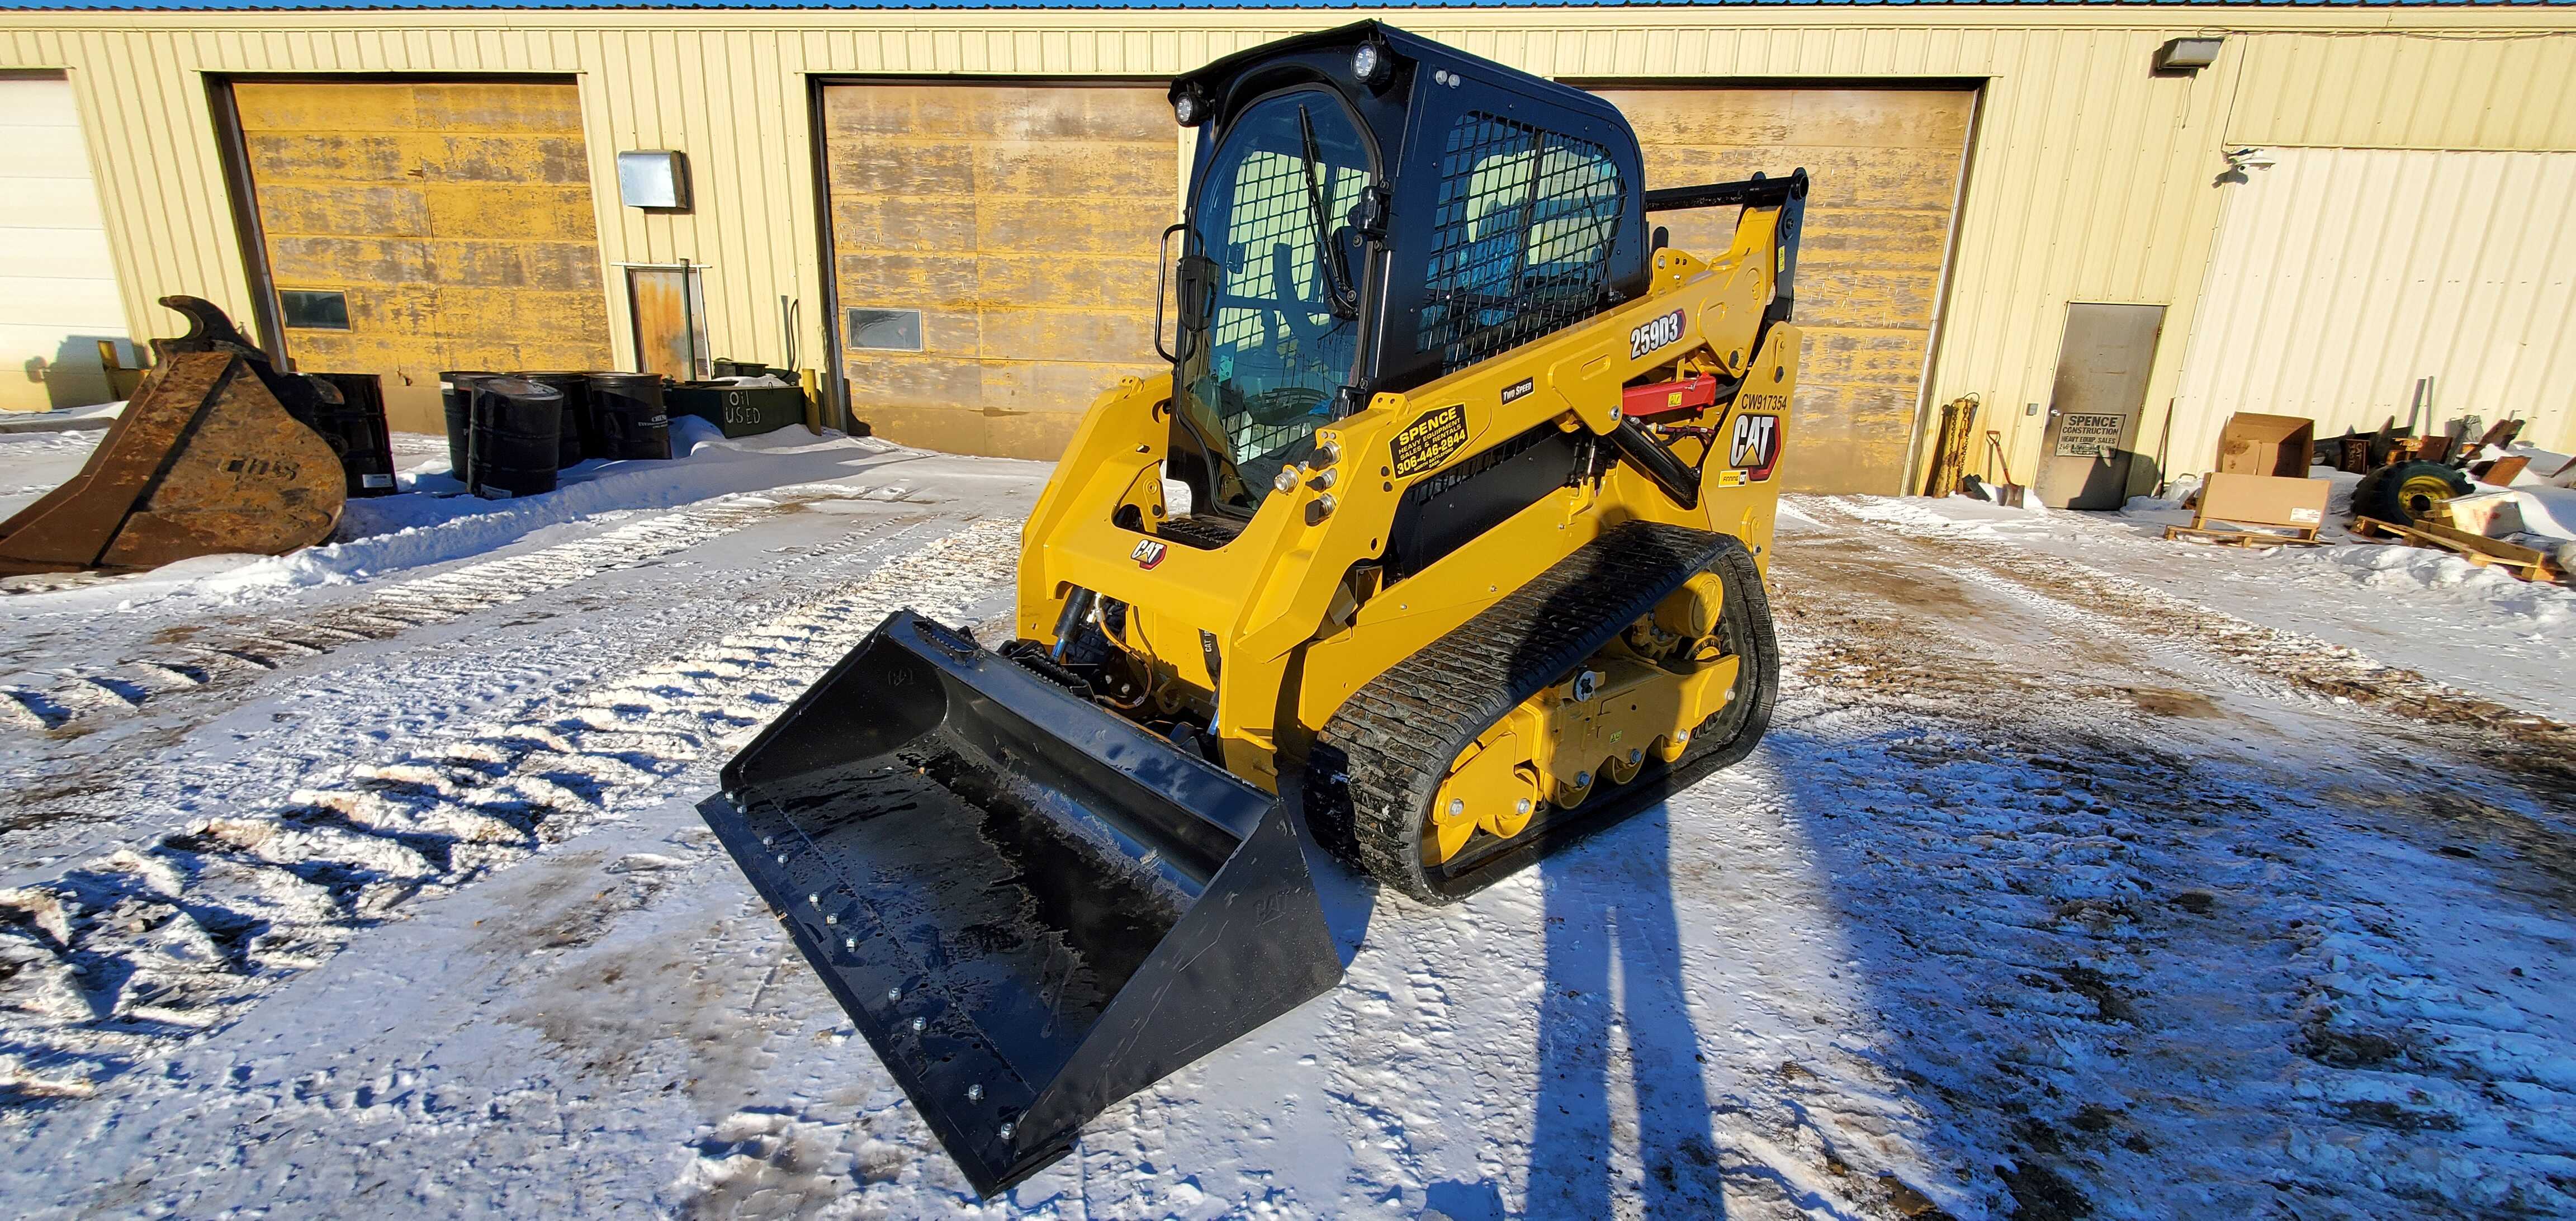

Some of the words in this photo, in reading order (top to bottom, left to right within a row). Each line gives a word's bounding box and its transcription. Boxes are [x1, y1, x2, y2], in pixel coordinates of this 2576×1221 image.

[1631, 313, 1678, 358] 259D3
[726, 406, 760, 424] USED
[1741, 393, 1788, 410] CW917354
[1398, 438, 1421, 455] HEAVY
[1423, 417, 1461, 441] EQUIPMENT
[1399, 406, 1457, 446] SPENCE
[2062, 427, 2119, 435] CONSTRUCTION
[2069, 415, 2118, 427] SPENCE
[1397, 428, 1466, 475] 306-446-2844
[1400, 444, 1422, 461] SALES
[1432, 424, 1461, 443] RENTALS
[1731, 415, 1774, 466] CAT
[1414, 461, 1428, 471] NORTH
[1131, 539, 1164, 564] CAT
